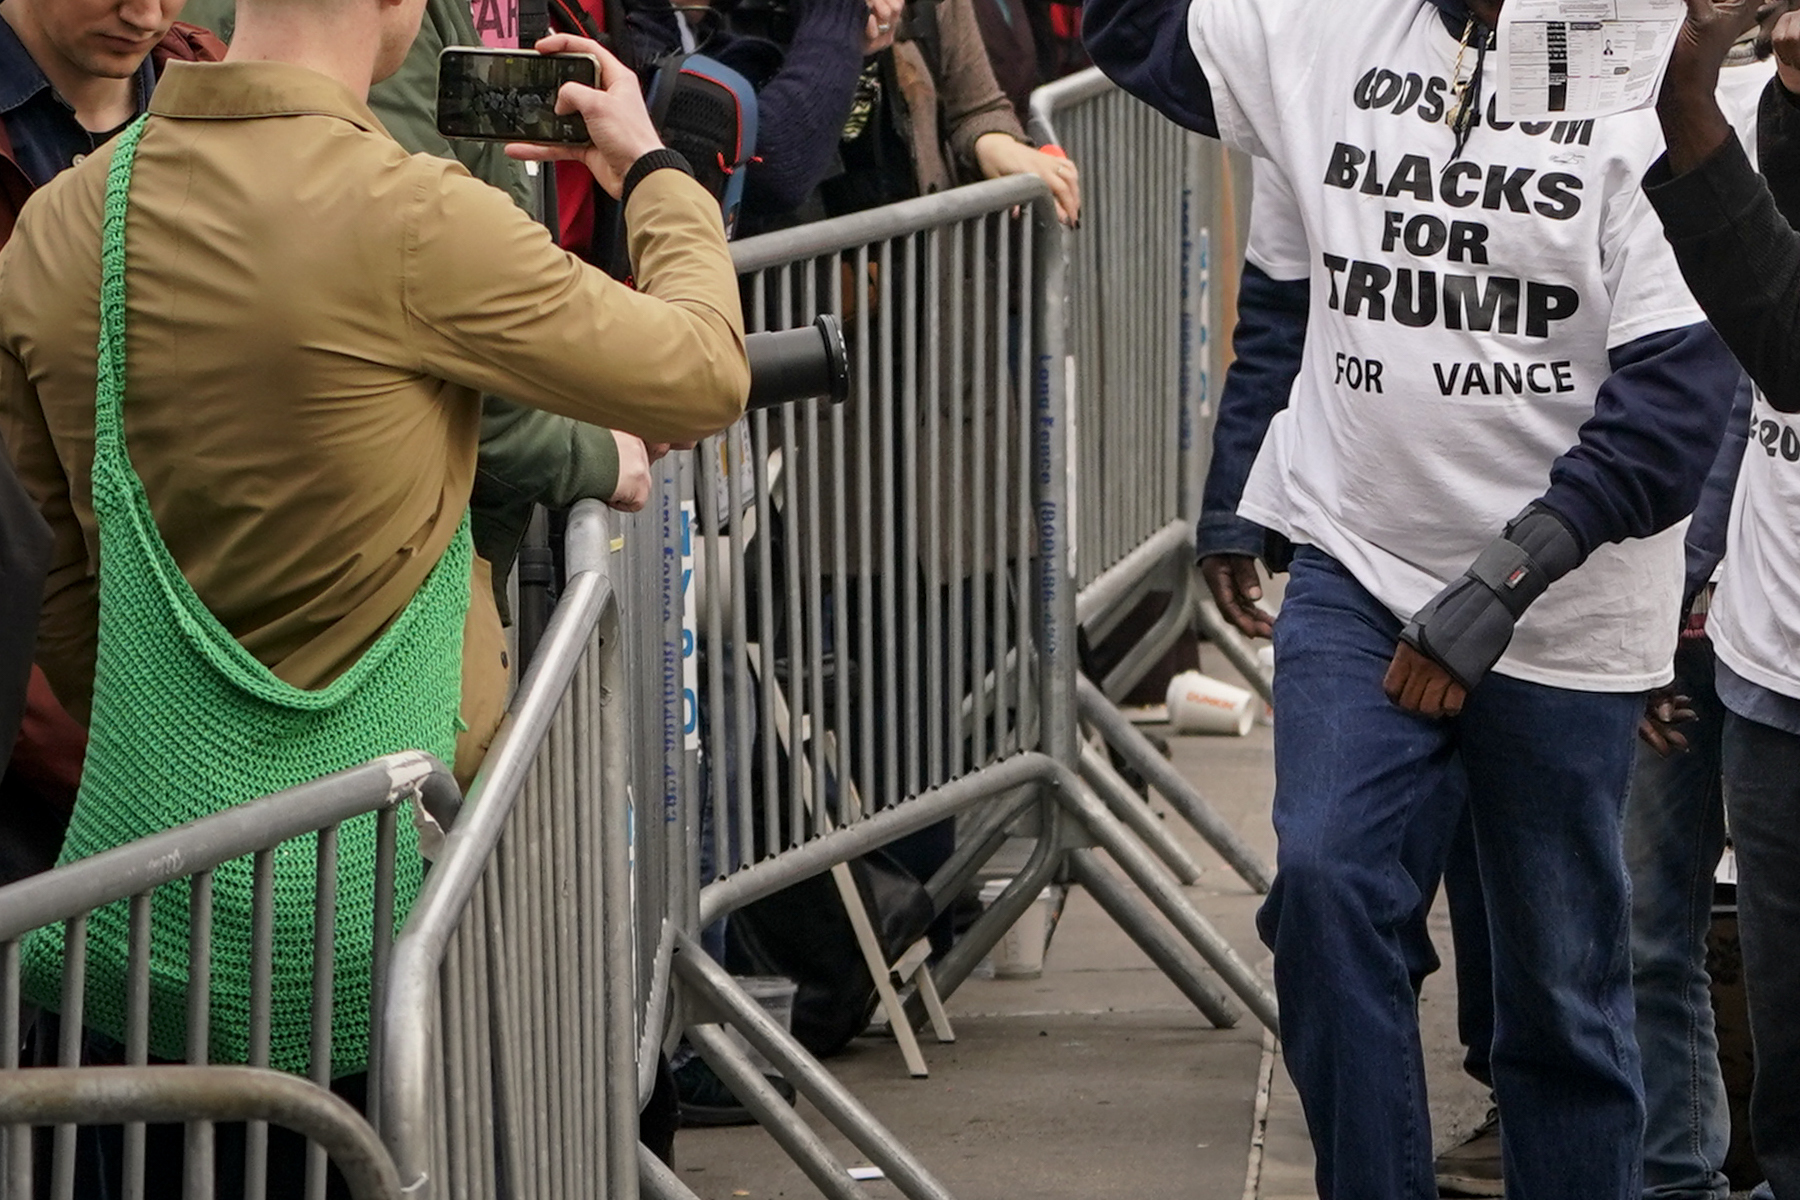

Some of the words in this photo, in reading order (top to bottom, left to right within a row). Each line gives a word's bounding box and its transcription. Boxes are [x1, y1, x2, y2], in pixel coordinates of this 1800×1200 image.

[1323, 141, 1584, 221] BLACKS
[1381, 210, 1489, 266] FOR
[1323, 252, 1580, 339] TRUMP
[1334, 352, 1384, 394] FOR
[1433, 361, 1575, 397] VANCE
[1039, 417, 1055, 485] Fence
